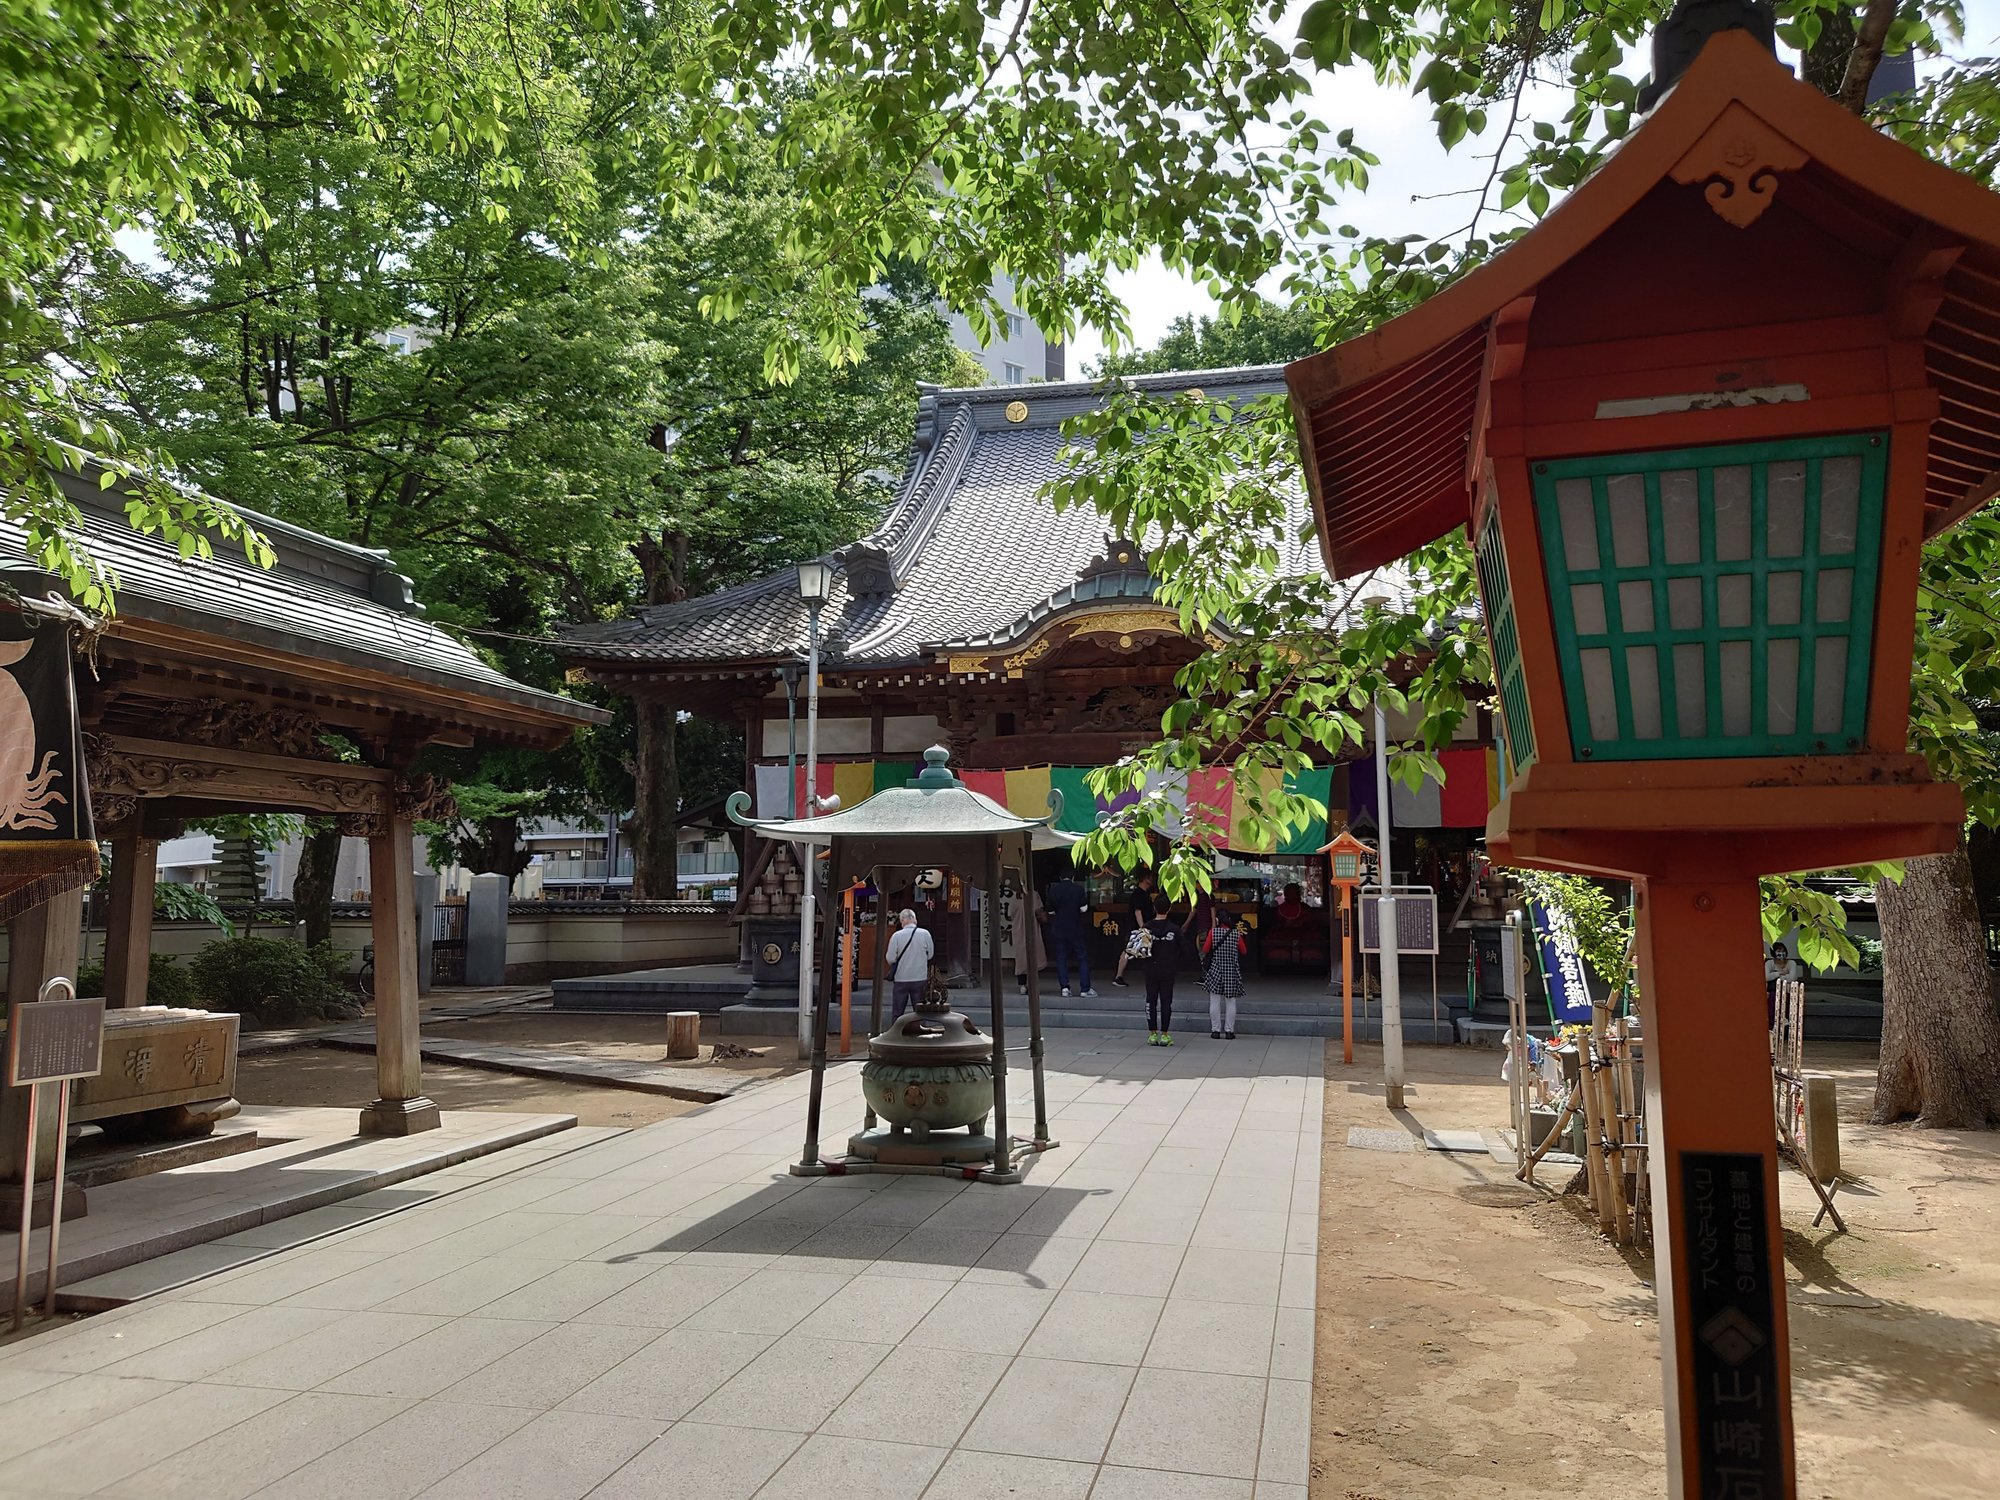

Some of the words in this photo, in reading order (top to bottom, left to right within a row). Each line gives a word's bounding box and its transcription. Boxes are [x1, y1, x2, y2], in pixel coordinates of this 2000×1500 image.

[1102, 920, 1120, 936] 納
[1695, 1168, 1720, 1291] コンサルタント
